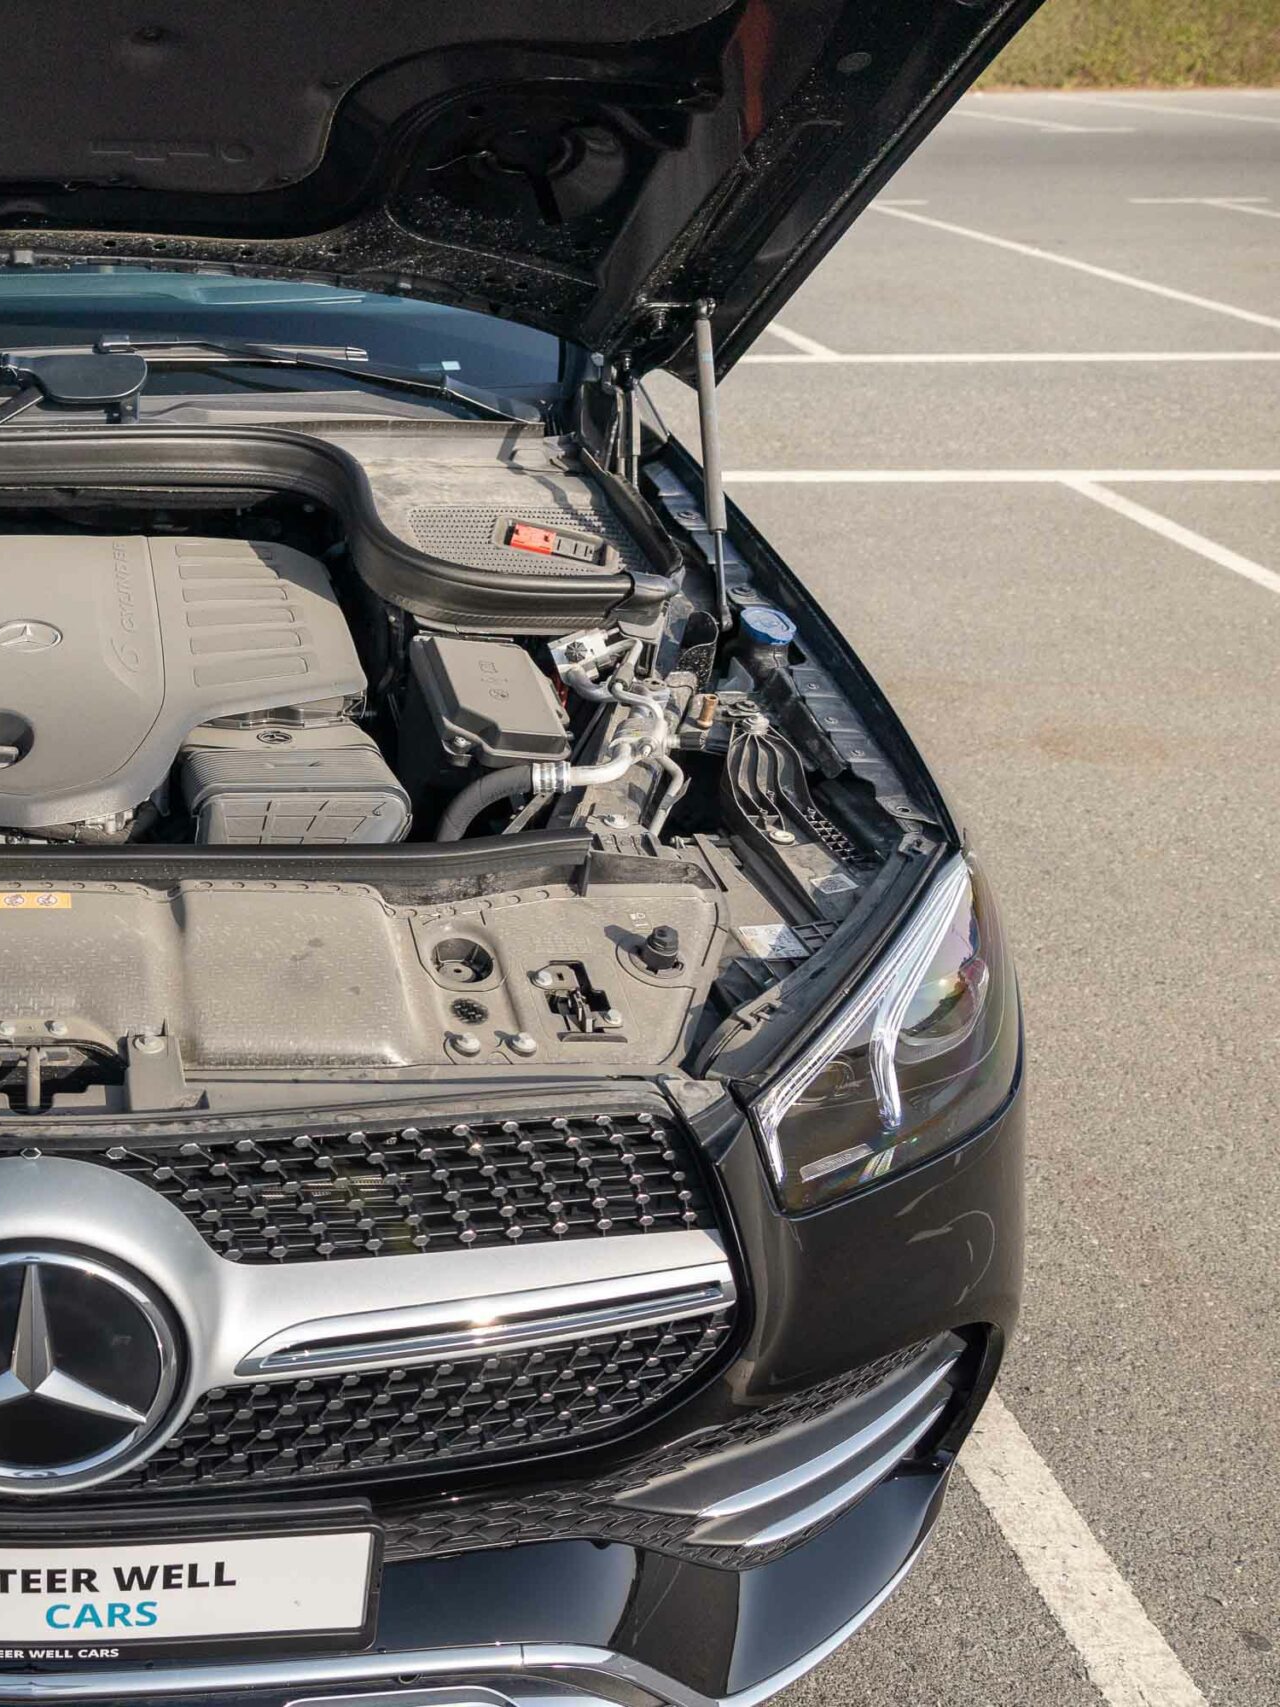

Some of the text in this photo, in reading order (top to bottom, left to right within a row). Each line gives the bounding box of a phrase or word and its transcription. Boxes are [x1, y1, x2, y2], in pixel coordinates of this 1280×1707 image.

[112, 539, 135, 632] CYLINDER
[113, 1561, 237, 1592] WELL
[45, 1601, 158, 1630] CARS
[28, 1649, 74, 1659] WELL
[77, 1648, 120, 1659] CARS
